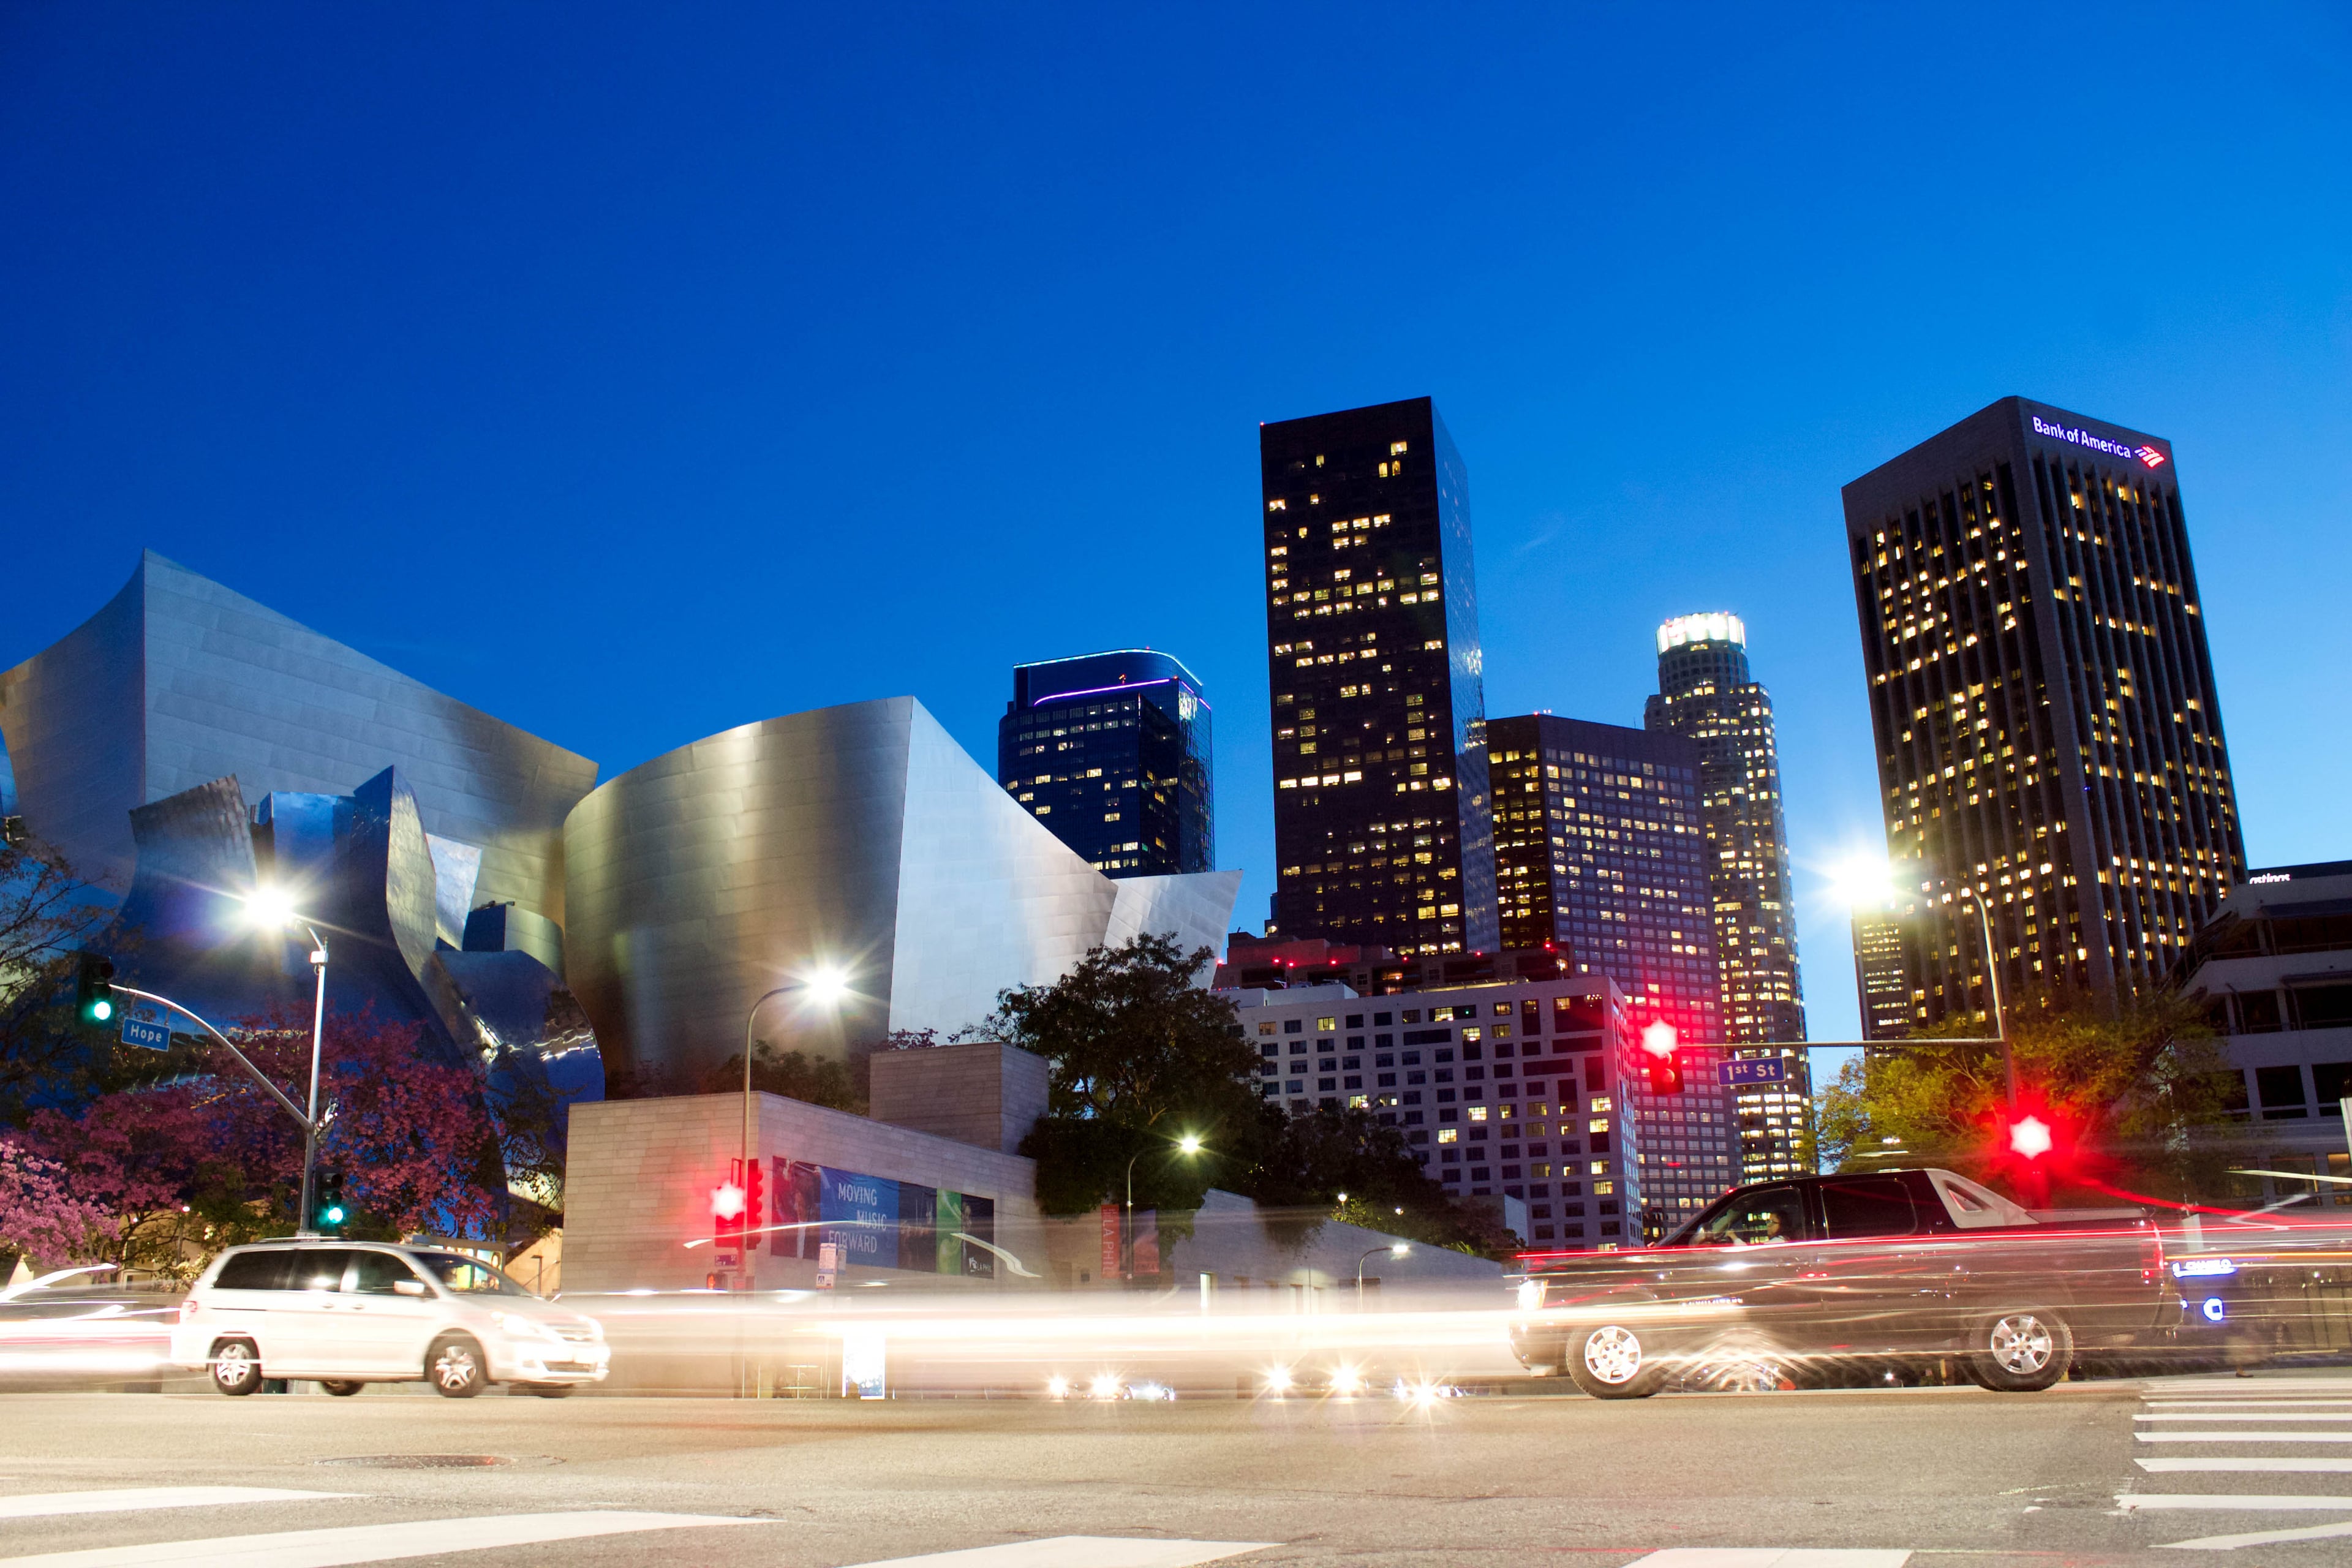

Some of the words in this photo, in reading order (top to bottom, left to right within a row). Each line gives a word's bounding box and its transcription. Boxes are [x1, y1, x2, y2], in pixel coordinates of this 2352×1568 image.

[2032, 417, 2065, 440] Bank
[2067, 428, 2079, 443] of
[2081, 431, 2131, 458] America
[130, 1024, 162, 1042] Hope
[1727, 1064, 1748, 1080] 1st
[1756, 1063, 1775, 1077] St
[839, 1182, 877, 1206] MOVING
[857, 1210, 887, 1231] MUSIC
[1103, 1219, 1114, 1236] LA
[829, 1230, 877, 1253] FORWARD
[1103, 1242, 1114, 1275] PHIL
